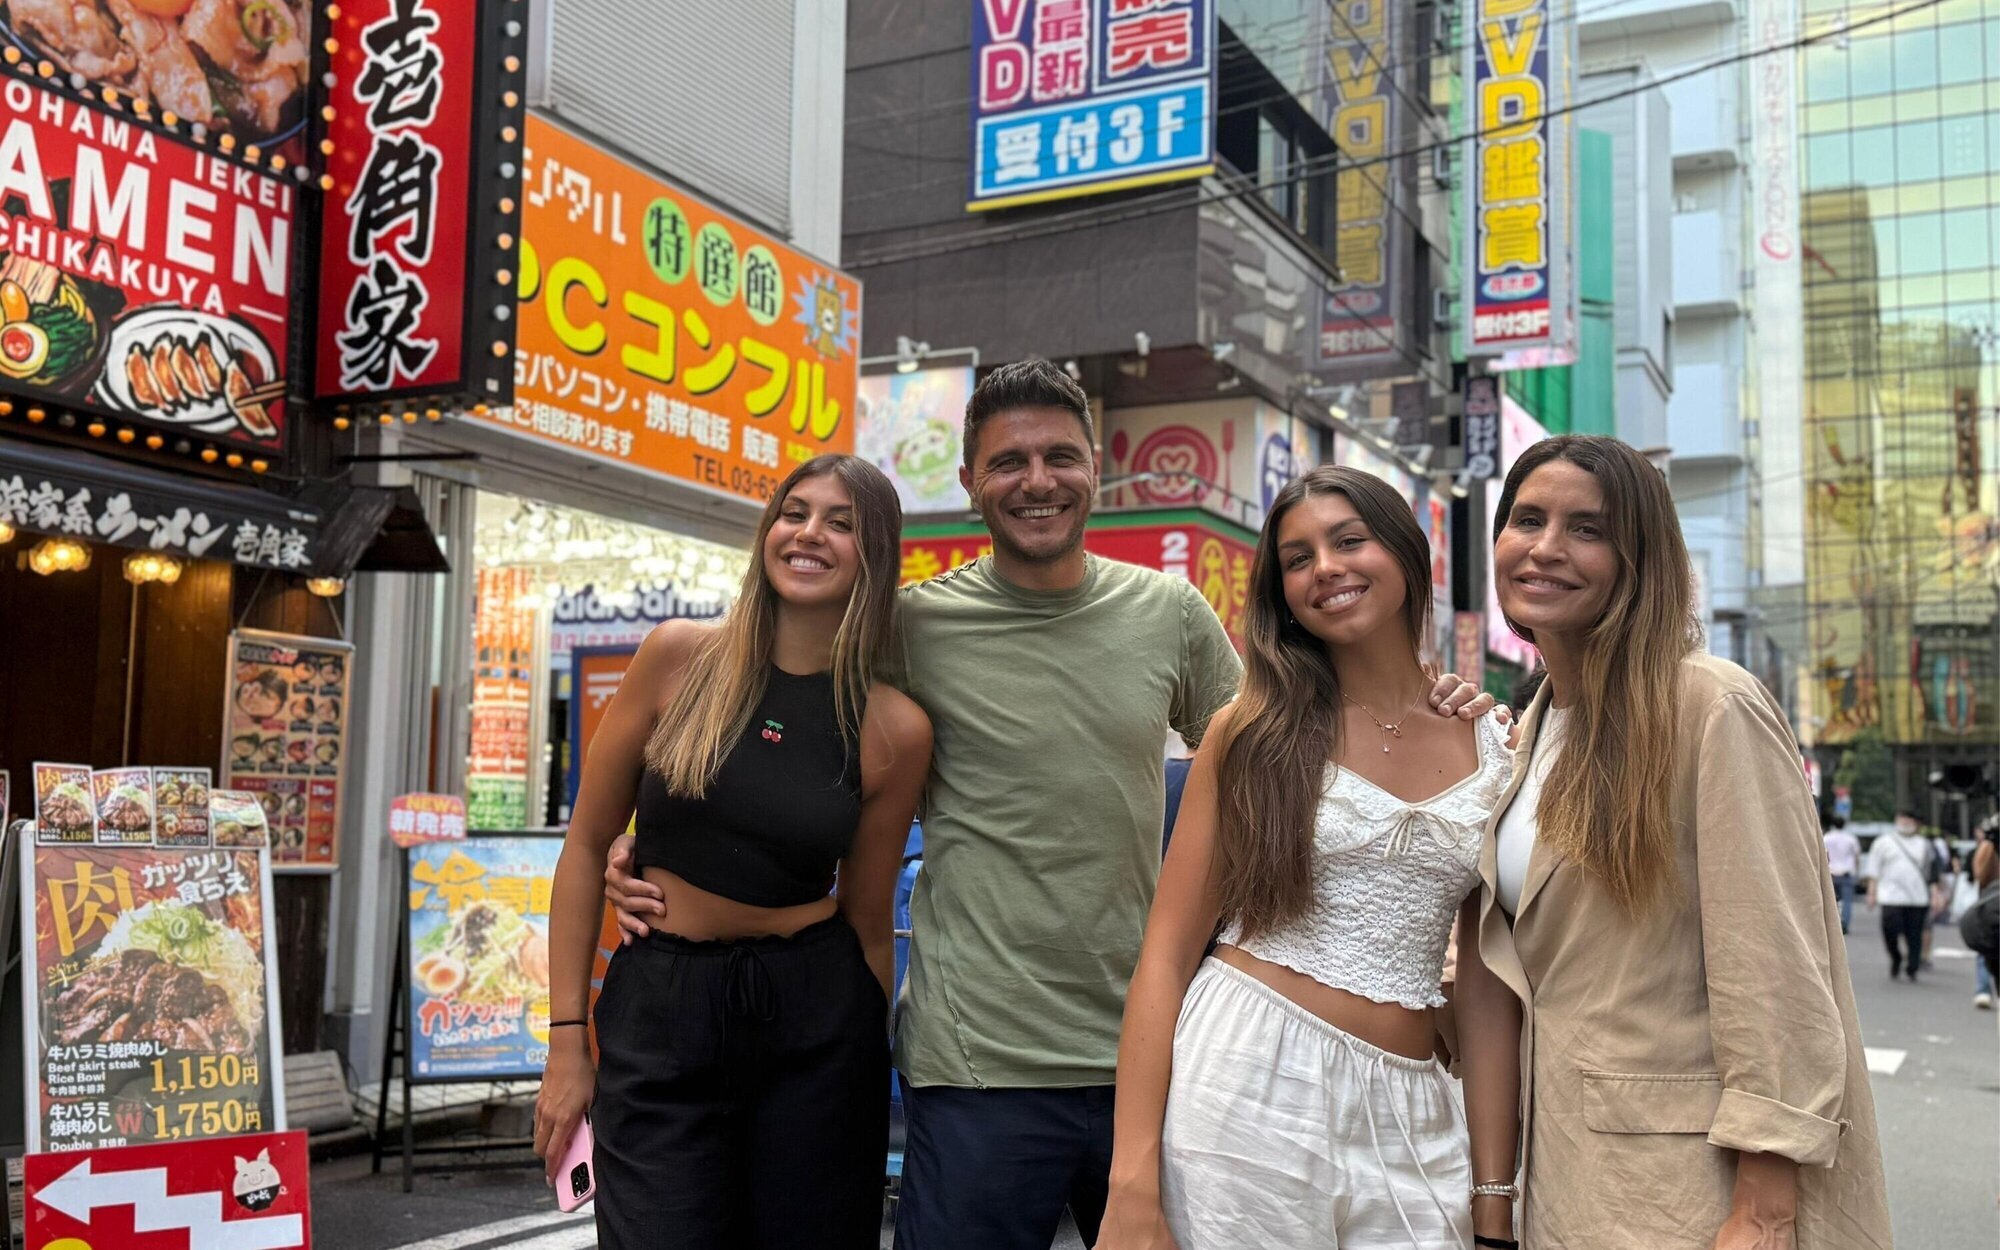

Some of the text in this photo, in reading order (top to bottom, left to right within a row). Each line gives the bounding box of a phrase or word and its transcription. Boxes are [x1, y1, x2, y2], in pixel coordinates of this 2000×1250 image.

[1108, 0, 1192, 78] 売
[5, 79, 290, 213] OHAMA IEKEI
[995, 95, 1186, 183] 受付3F
[1479, 0, 1546, 273] VD鑑賞
[0, 118, 288, 297] AMEN
[338, 0, 443, 390] 壱角家
[650, 206, 776, 318] 特選館
[1475, 308, 1549, 338] 受付3F
[742, 425, 779, 468] 販売
[693, 454, 727, 487] TEL
[233, 519, 312, 568] 壱角家
[141, 851, 232, 888] ガッツリ
[176, 872, 249, 904] 食らえ
[47, 861, 135, 956] 肉
[48, 1041, 168, 1060] 牛ハラミ焼肉めし
[48, 1058, 141, 1073] Beef skirt steak
[48, 1072, 106, 1083] Rice Bowl
[50, 1102, 111, 1120] 牛ハラミ
[50, 1118, 112, 1136] 焼肉めし
[115, 1111, 143, 1136] W
[50, 1140, 92, 1152] Double
